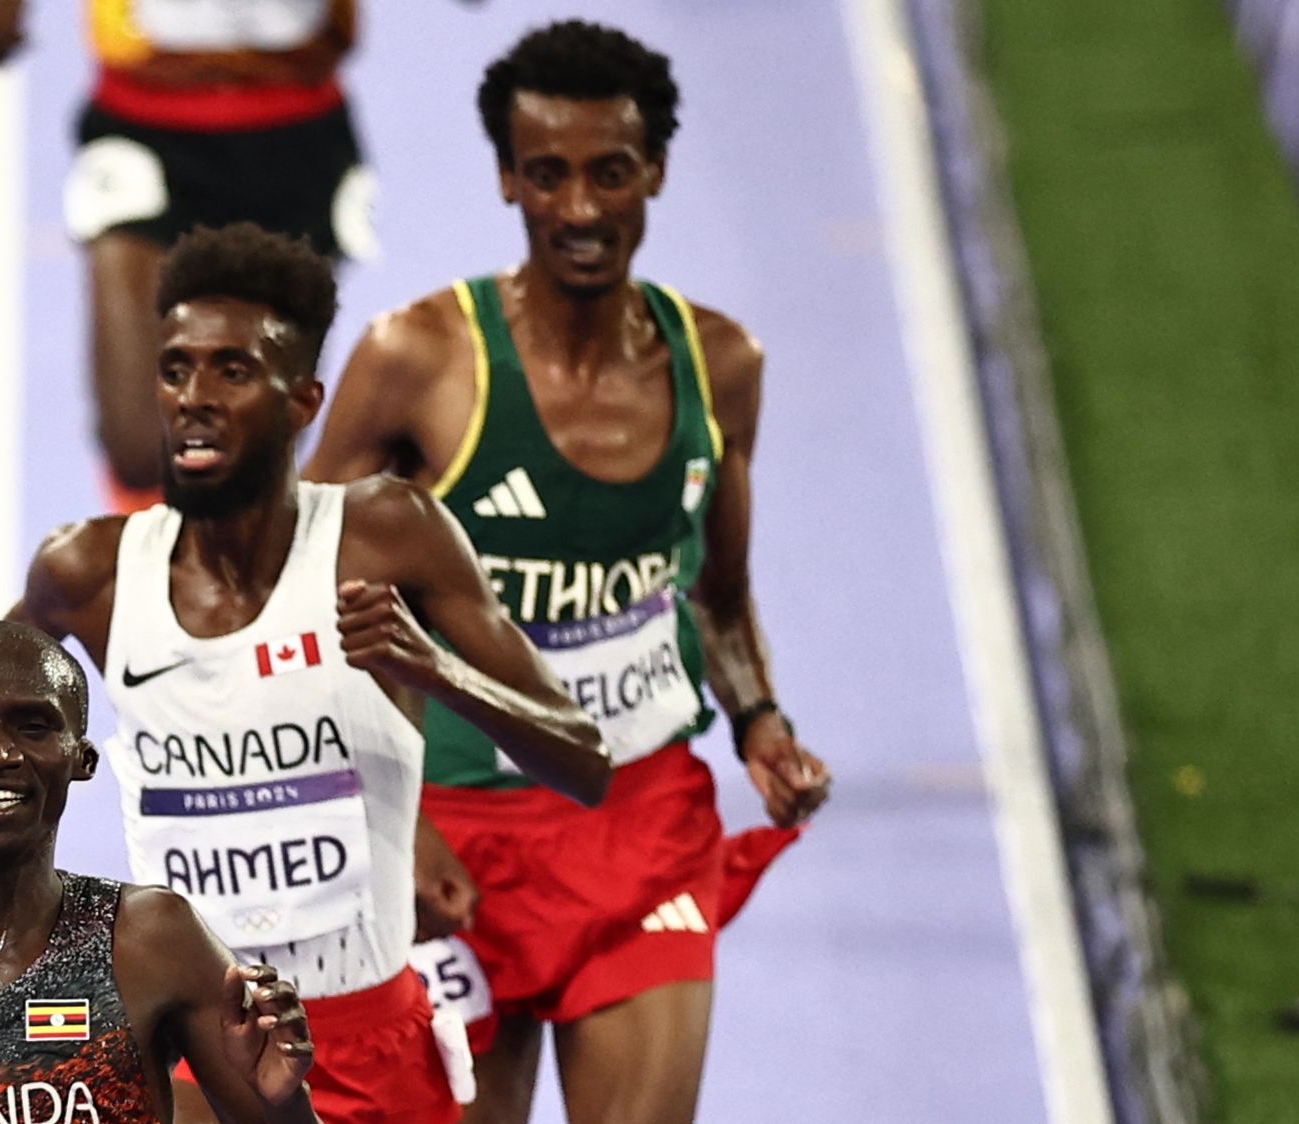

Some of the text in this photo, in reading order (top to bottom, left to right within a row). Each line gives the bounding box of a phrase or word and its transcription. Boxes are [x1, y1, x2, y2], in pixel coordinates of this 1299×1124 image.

[136, 716, 349, 777] CANADA
[183, 791, 240, 811] PARIS
[165, 835, 347, 896] AHMED
